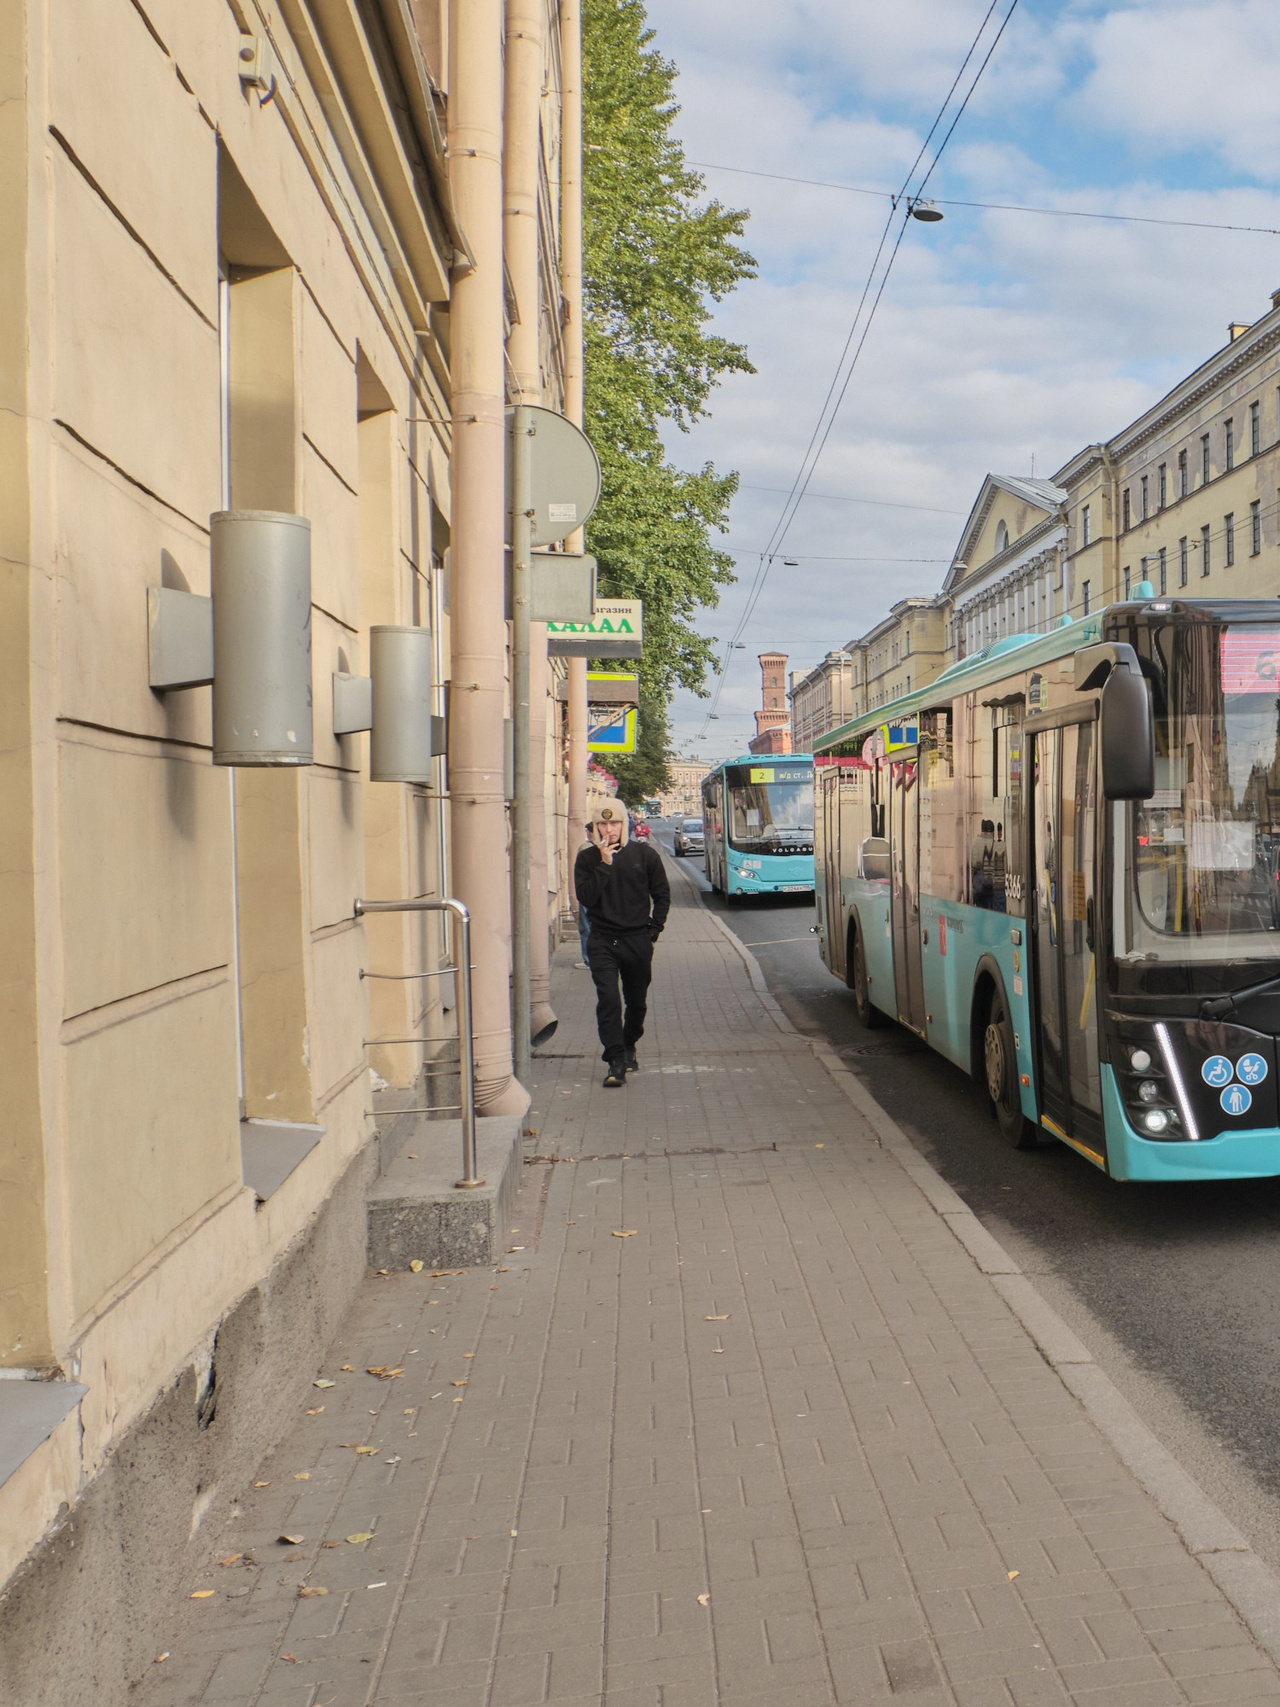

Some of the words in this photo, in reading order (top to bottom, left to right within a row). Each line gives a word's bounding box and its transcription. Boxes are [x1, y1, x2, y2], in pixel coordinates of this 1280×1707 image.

[1256, 651, 1276, 680] 6
[759, 771, 765, 780] 2
[1005, 873, 1020, 899] 5366
